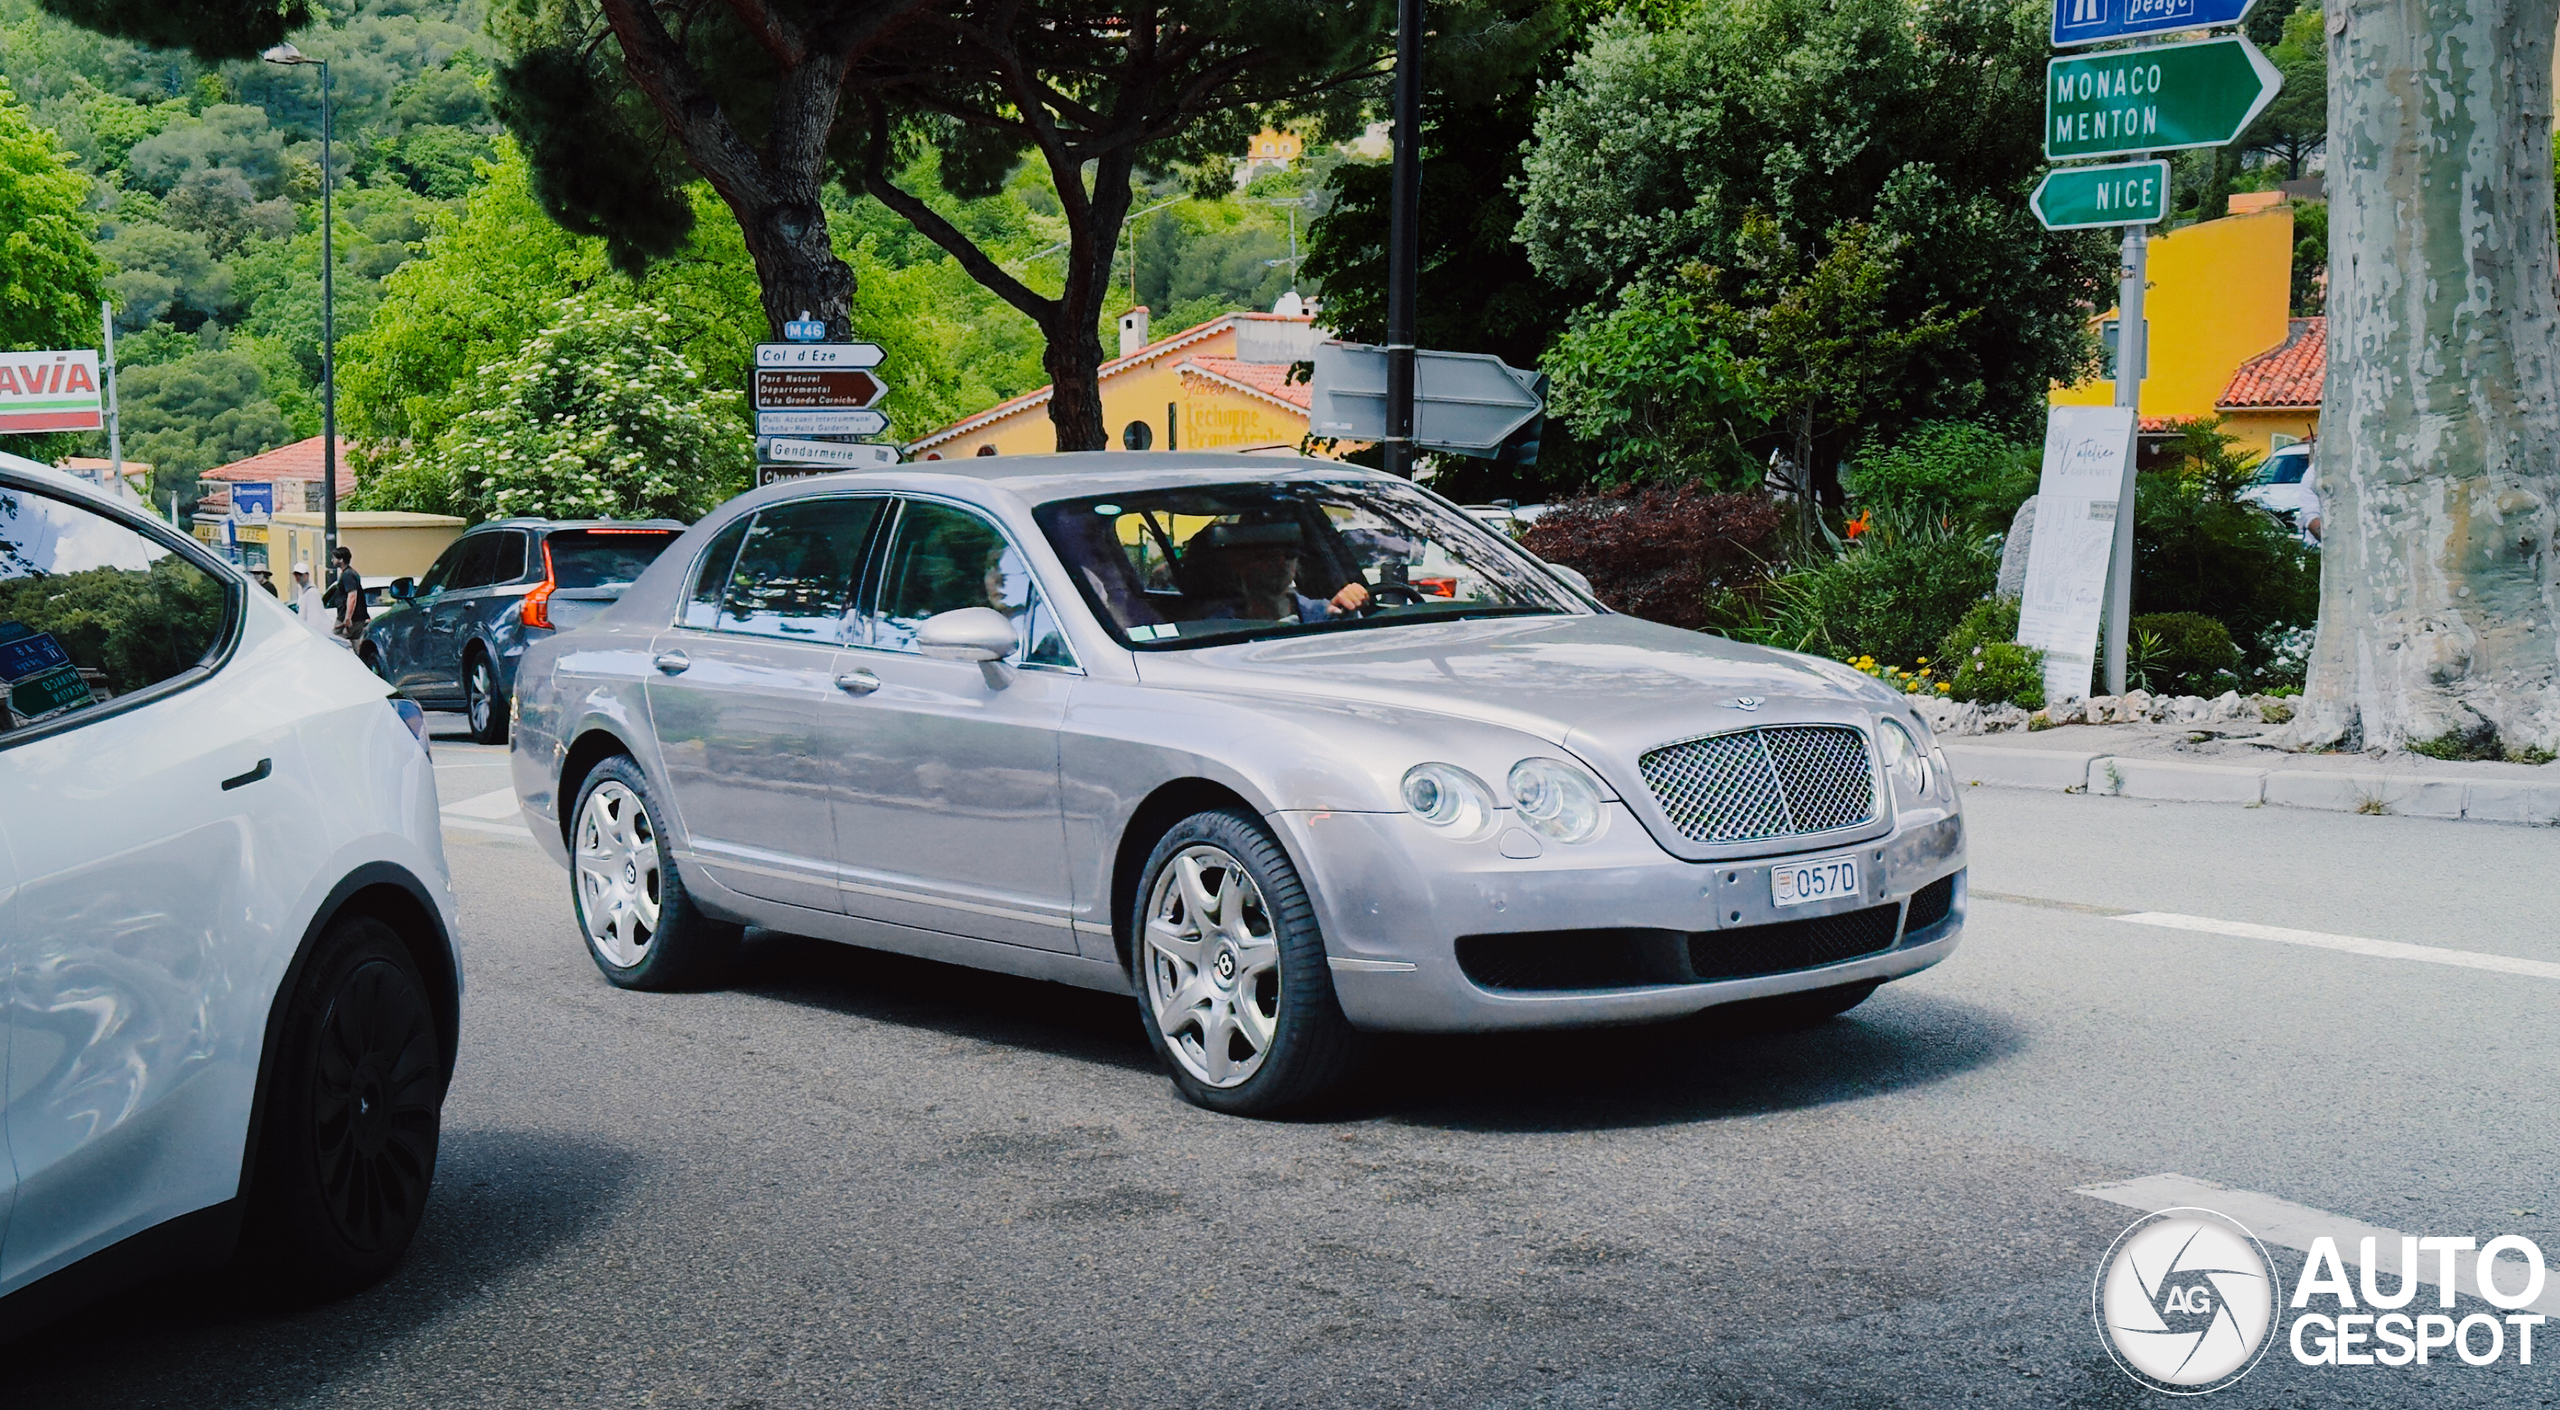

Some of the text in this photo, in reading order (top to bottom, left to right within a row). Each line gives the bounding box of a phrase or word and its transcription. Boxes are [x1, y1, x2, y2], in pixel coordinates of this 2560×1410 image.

[2057, 64, 2161, 104] MONACO
[2055, 105, 2157, 143] MENTON
[2096, 178, 2154, 211] NICE
[788, 325, 822, 337] M 46
[763, 350, 786, 361] Col
[760, 375, 821, 383] Parc Naturel
[760, 385, 831, 394] Départemental
[760, 396, 771, 404] de
[785, 396, 816, 404] Grande
[819, 396, 857, 404] Corniche
[762, 414, 871, 423] Multi Accueil Intercommunal
[774, 444, 854, 460] Gendarmerie
[1797, 862, 1855, 898] 057D
